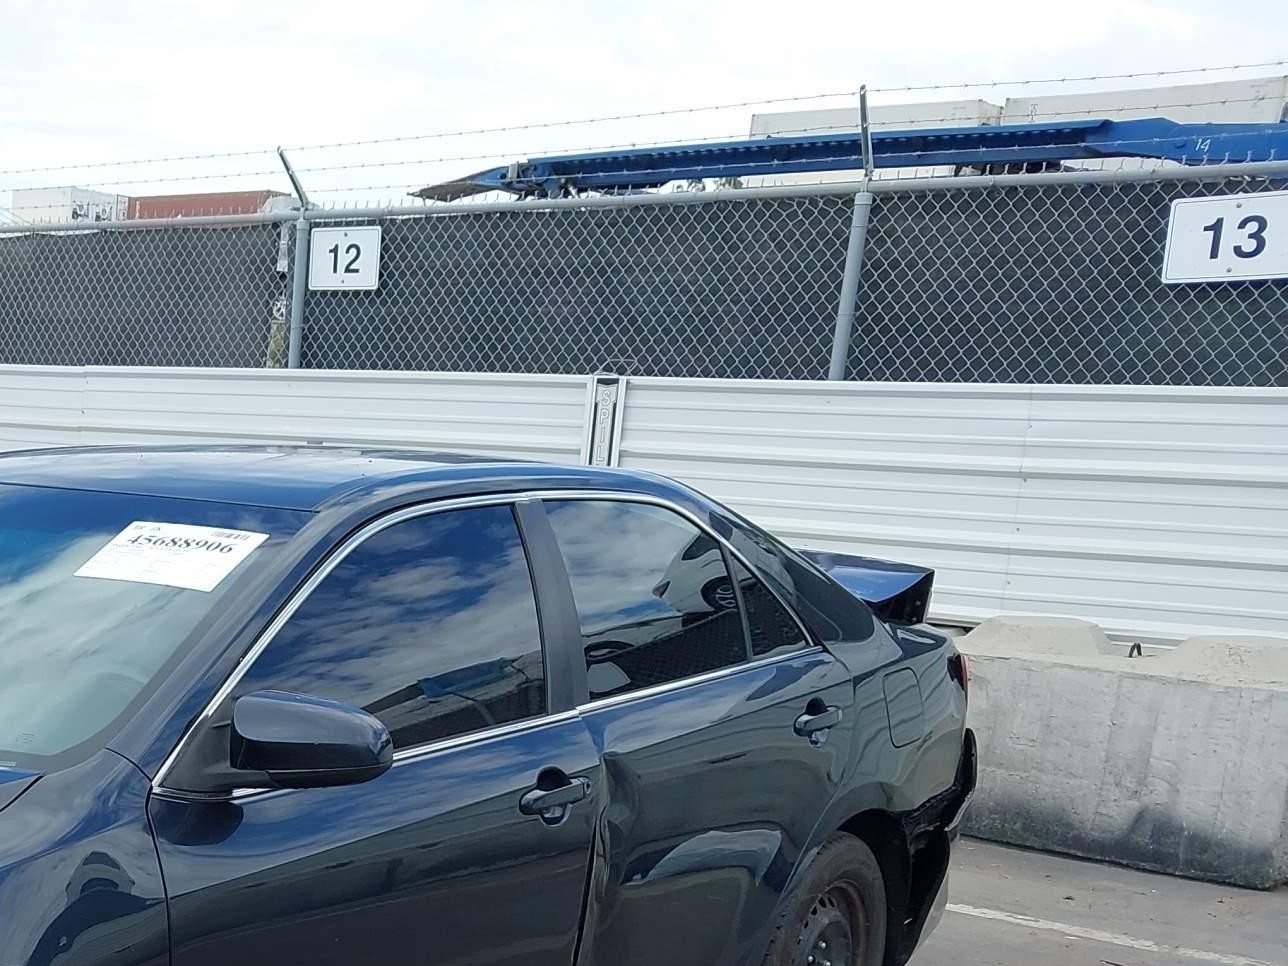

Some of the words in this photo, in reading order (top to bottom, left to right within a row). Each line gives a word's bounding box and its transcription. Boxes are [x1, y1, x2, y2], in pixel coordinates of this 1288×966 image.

[1195, 138, 1211, 153] 14
[1202, 214, 1268, 260] 13
[327, 243, 362, 275] 12
[595, 389, 612, 464] SPIL
[127, 534, 237, 554] 45688906
